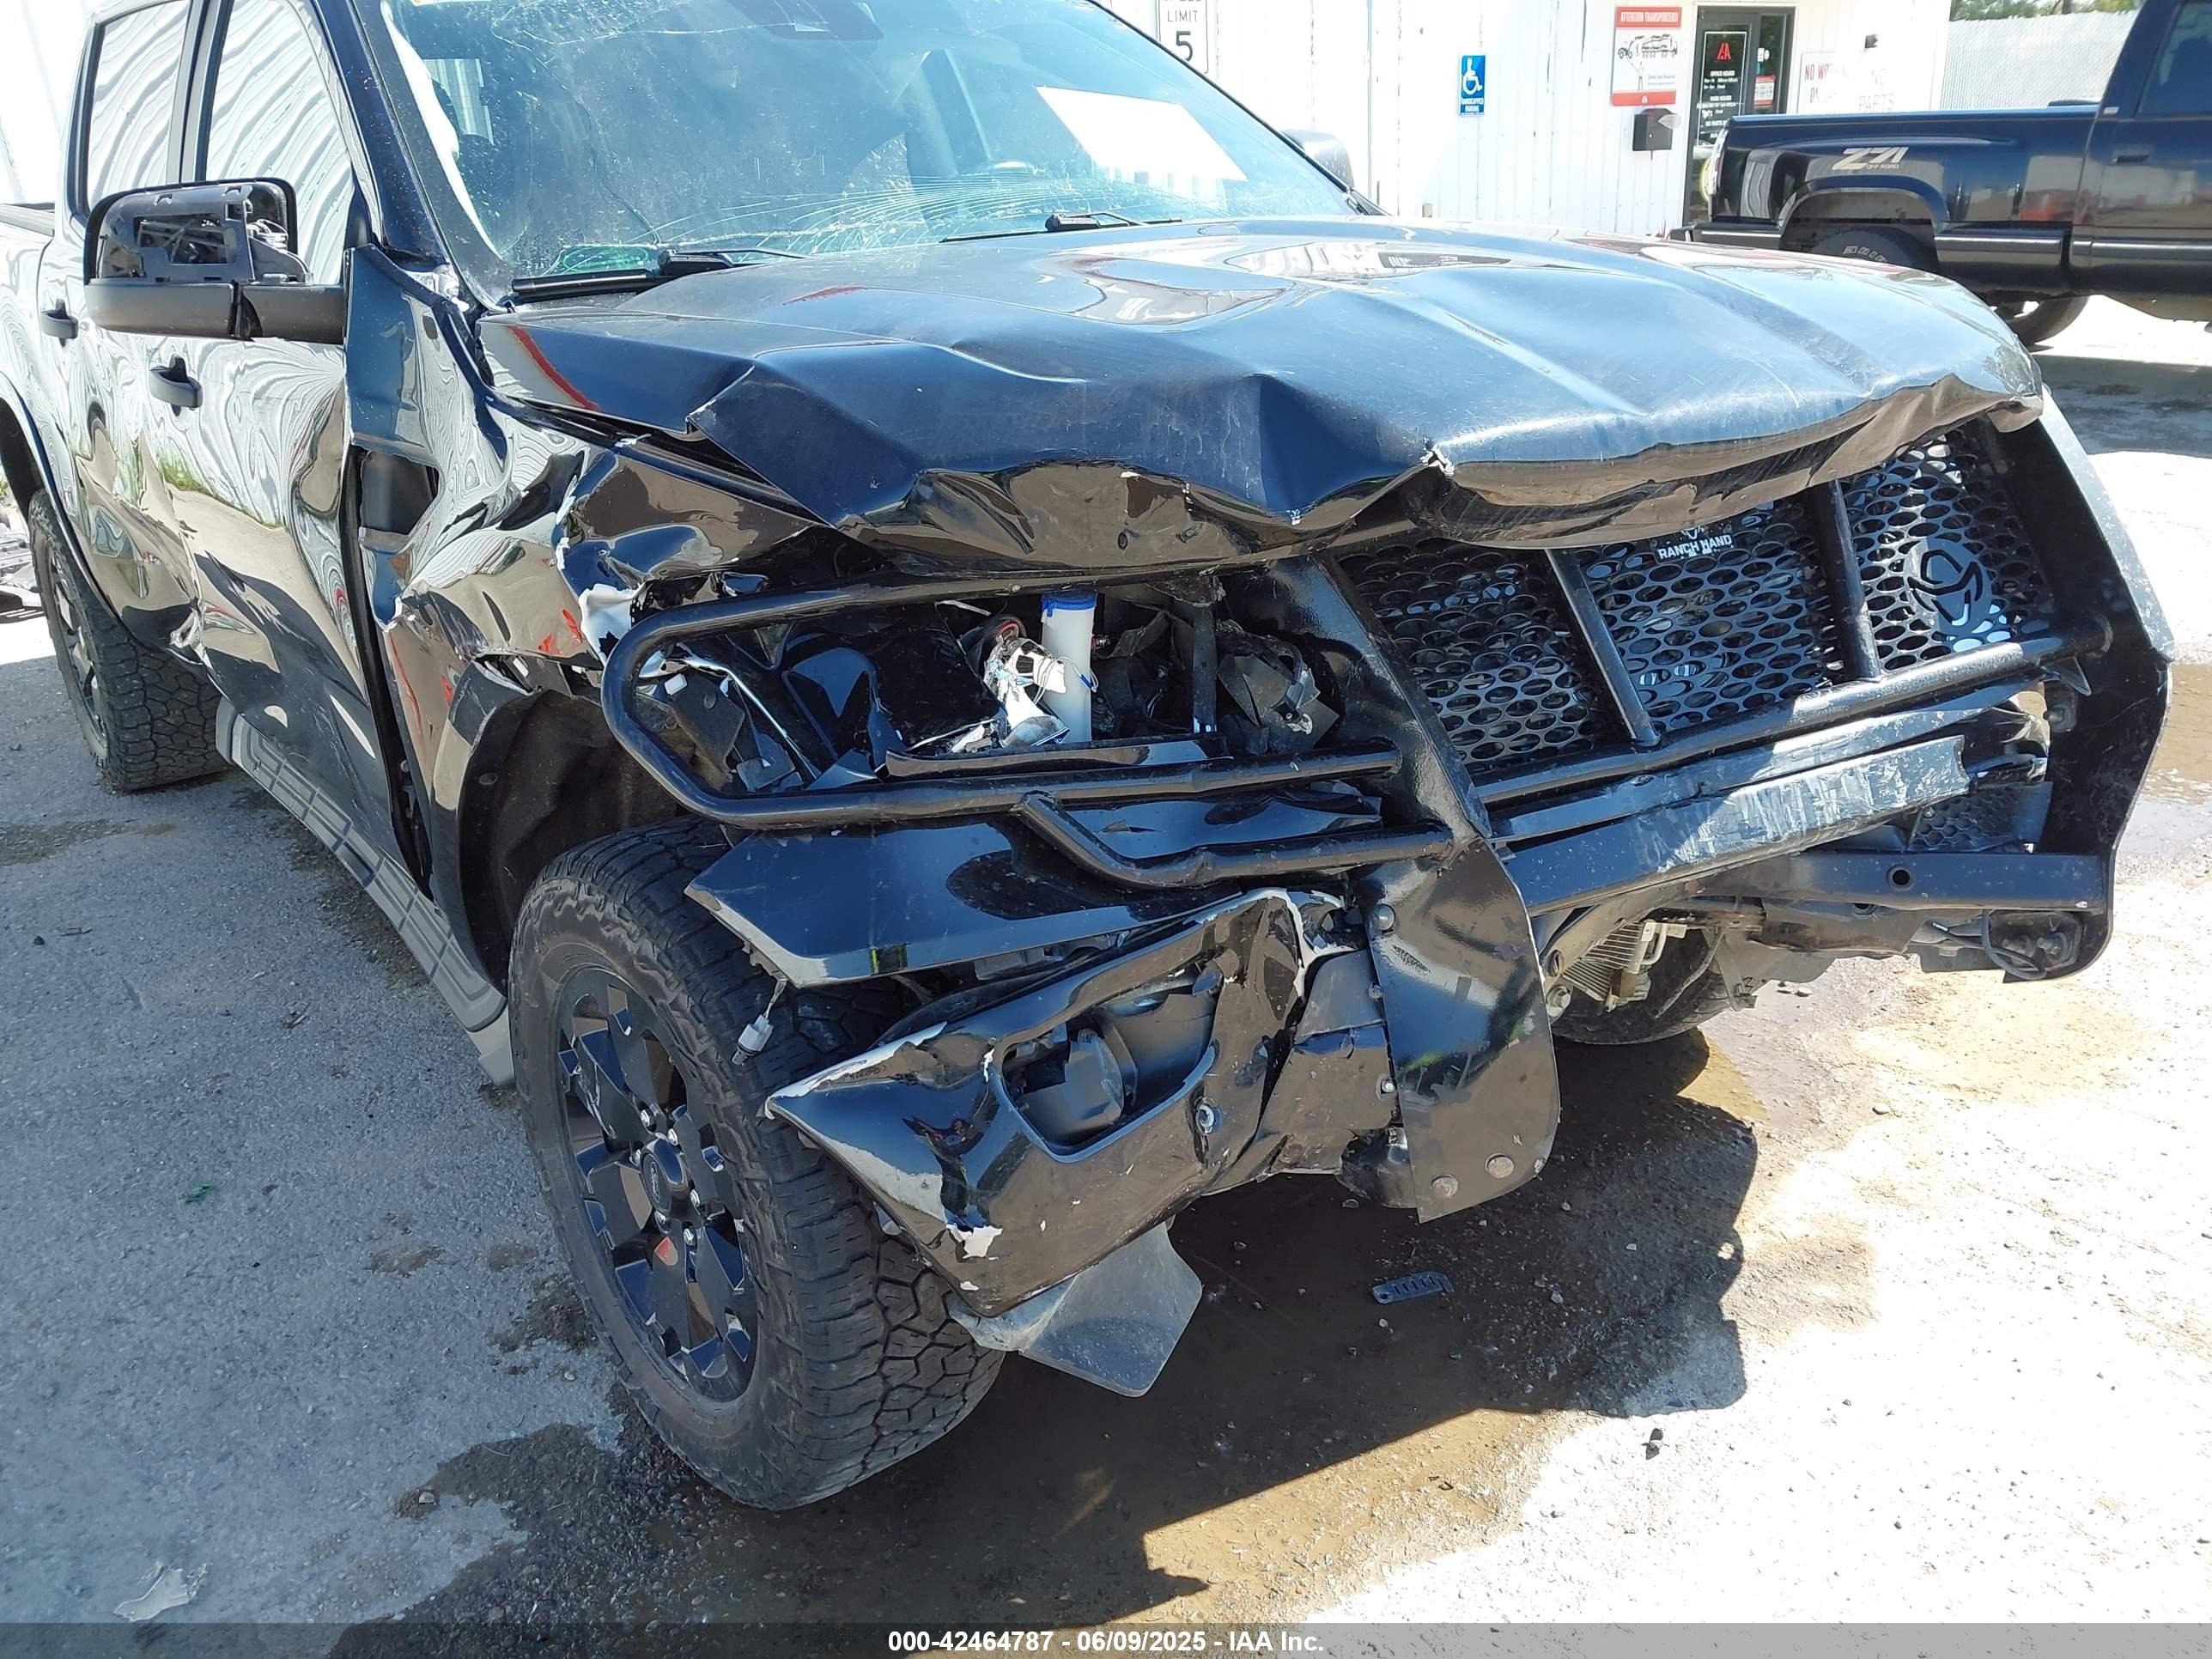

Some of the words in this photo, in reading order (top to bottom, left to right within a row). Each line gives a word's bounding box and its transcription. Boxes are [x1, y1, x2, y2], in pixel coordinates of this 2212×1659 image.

[1168, 9, 1198, 22] LIMIT
[1176, 30, 1193, 62] 5
[1832, 146, 1910, 170] Z71
[1658, 540, 1700, 560] RANCH
[1699, 534, 1733, 553] HAND
